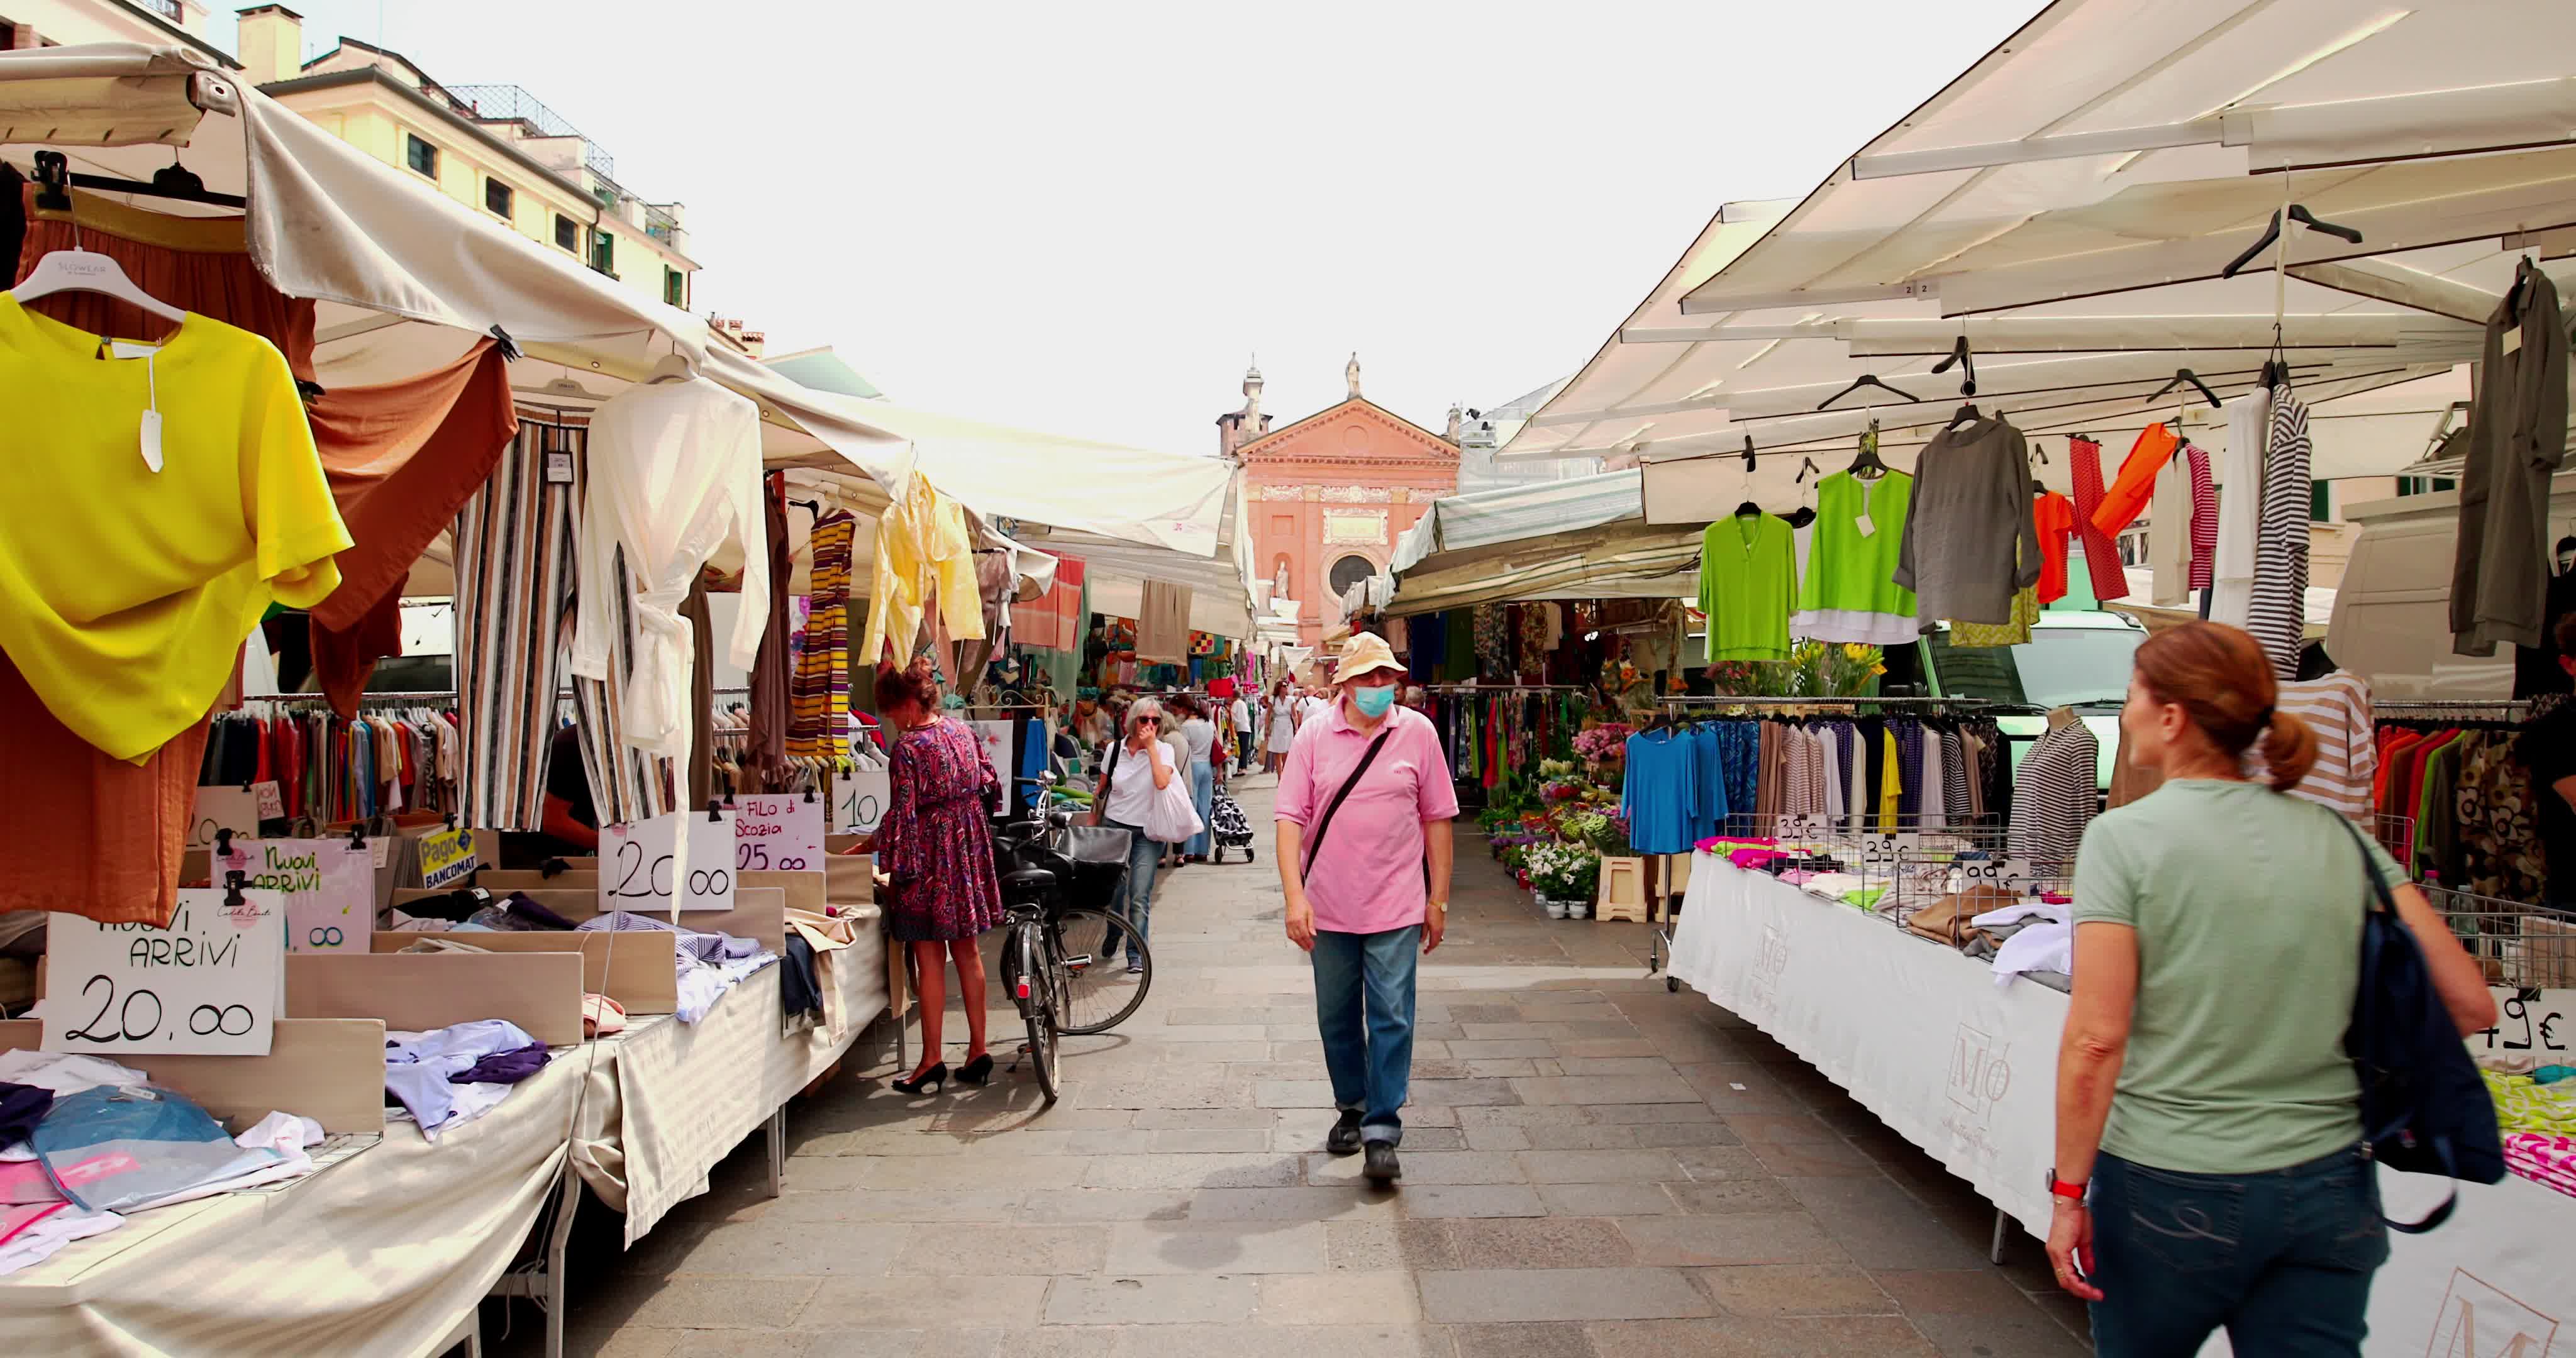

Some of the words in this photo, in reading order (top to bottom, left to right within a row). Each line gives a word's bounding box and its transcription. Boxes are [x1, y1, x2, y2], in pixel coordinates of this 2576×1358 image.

[786, 799, 795, 814] di
[422, 836, 456, 866] Pago
[426, 855, 475, 889] BANCOMAT
